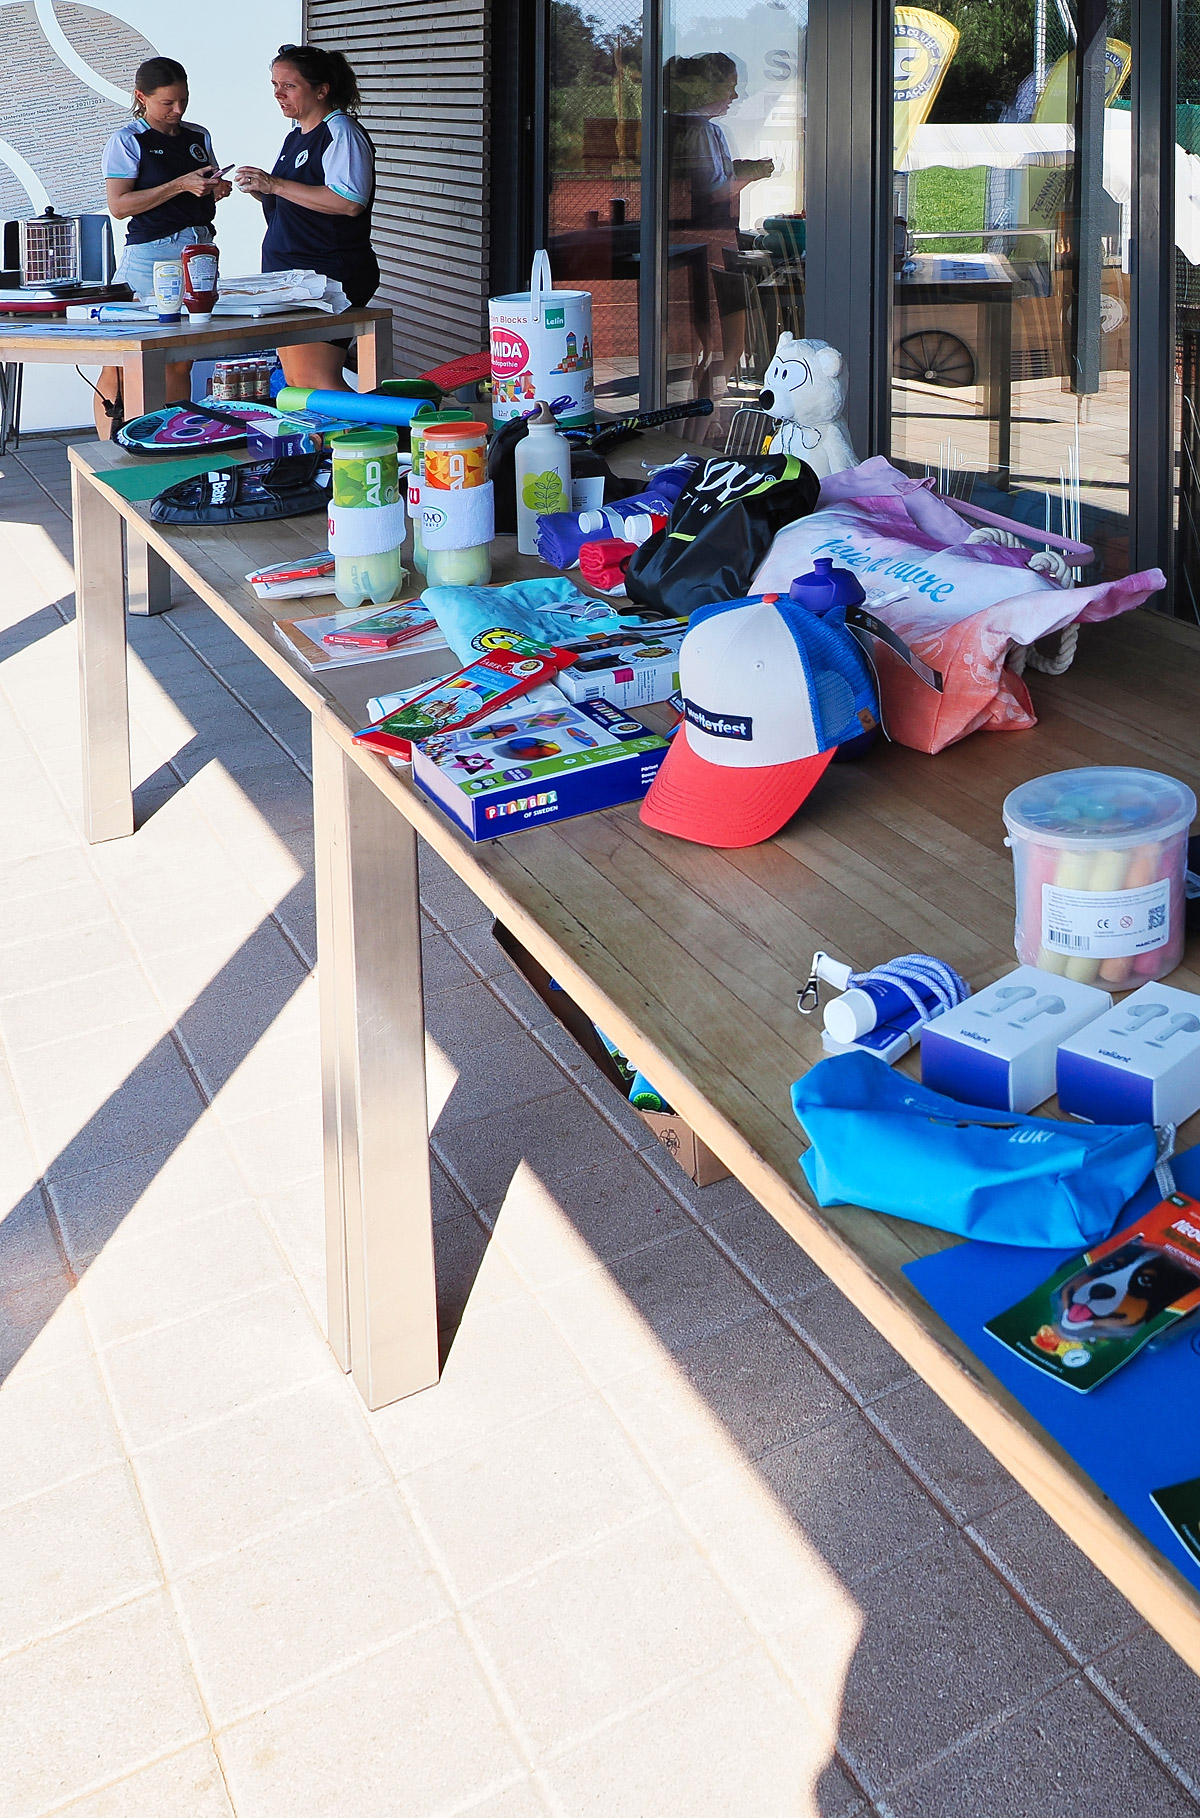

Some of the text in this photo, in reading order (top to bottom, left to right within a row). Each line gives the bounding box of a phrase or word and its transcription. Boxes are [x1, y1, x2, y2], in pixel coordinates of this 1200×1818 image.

[500, 316, 528, 324] Blocks
[686, 706, 747, 736] wetterfest
[485, 790, 557, 819] PLAYBOX
[524, 805, 559, 819] OF SWEDEN
[960, 1029, 991, 1044] valiant
[1098, 1048, 1132, 1063] valiant
